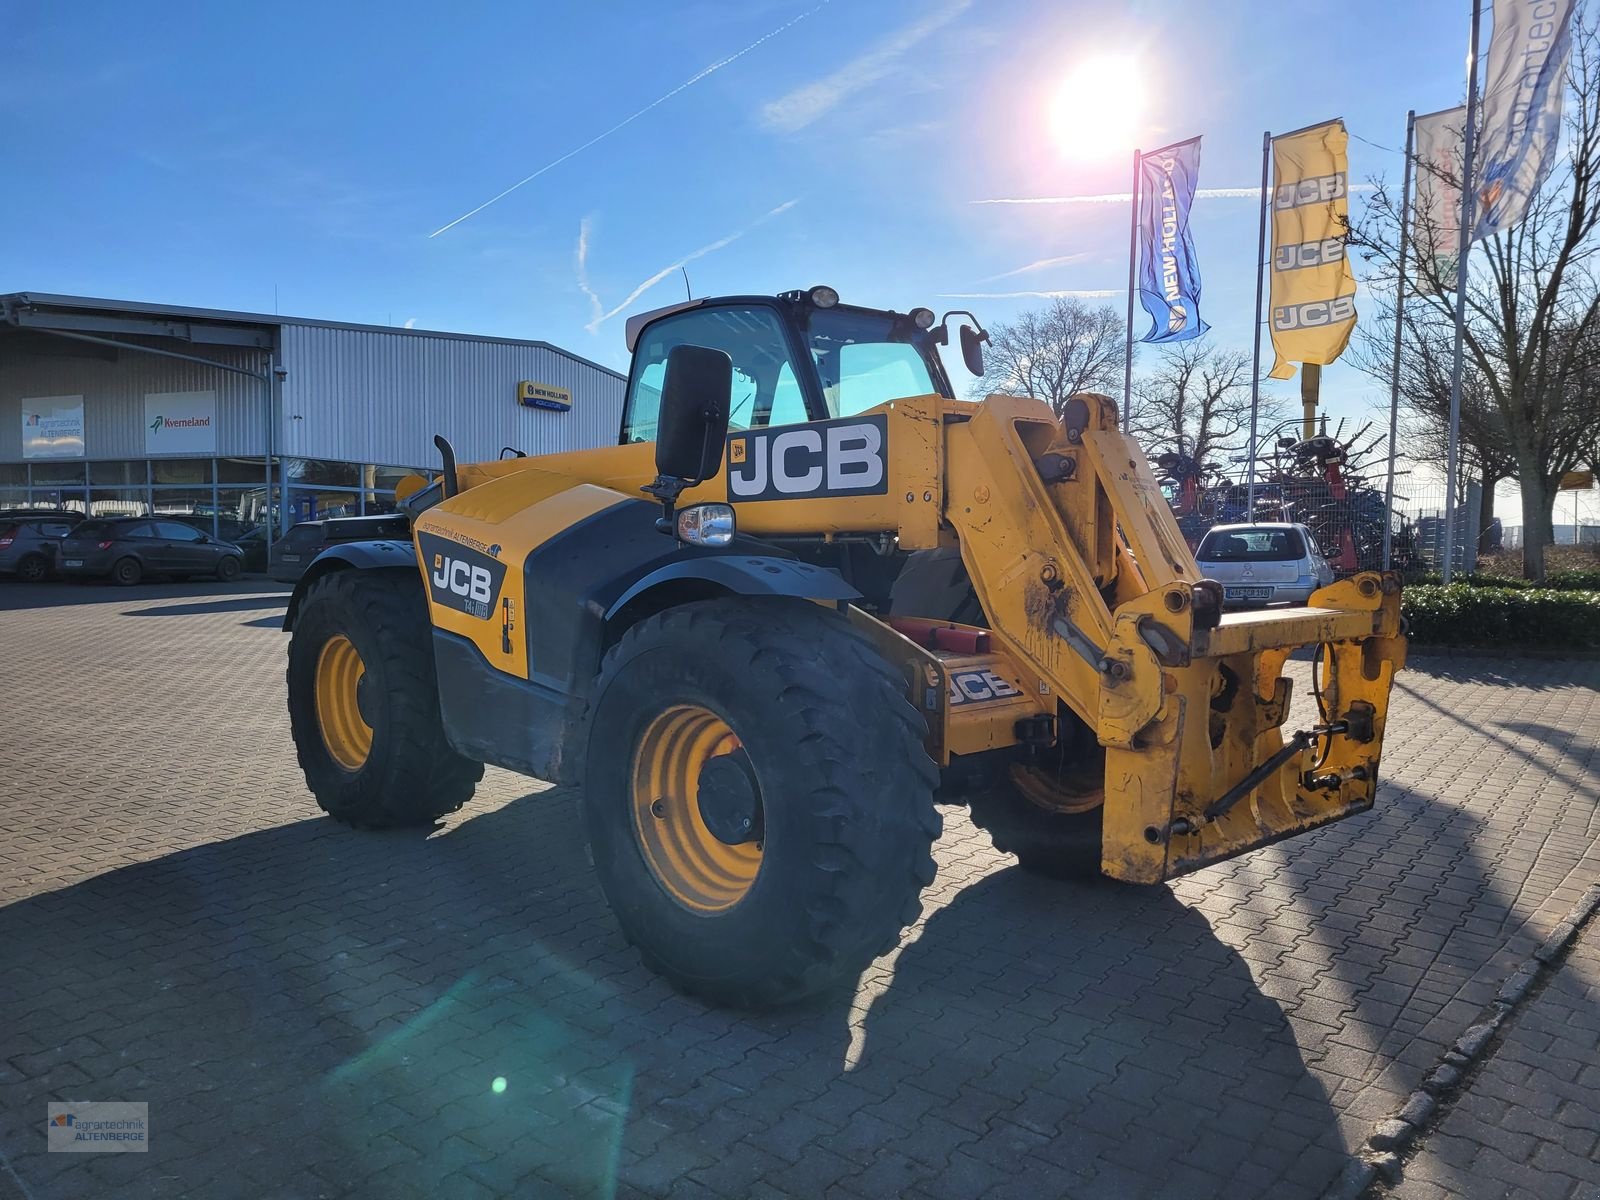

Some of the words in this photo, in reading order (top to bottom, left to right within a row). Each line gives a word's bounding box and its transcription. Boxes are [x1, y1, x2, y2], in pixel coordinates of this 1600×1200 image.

[1161, 157, 1178, 252] HOLLAD
[1276, 174, 1344, 208] JCB
[1162, 256, 1181, 301] NEW
[1276, 296, 1354, 329] JCB
[164, 416, 210, 428] Kverneland
[730, 423, 883, 496] JCB
[453, 532, 487, 552] ALTENBERGE
[433, 557, 491, 603] JCB
